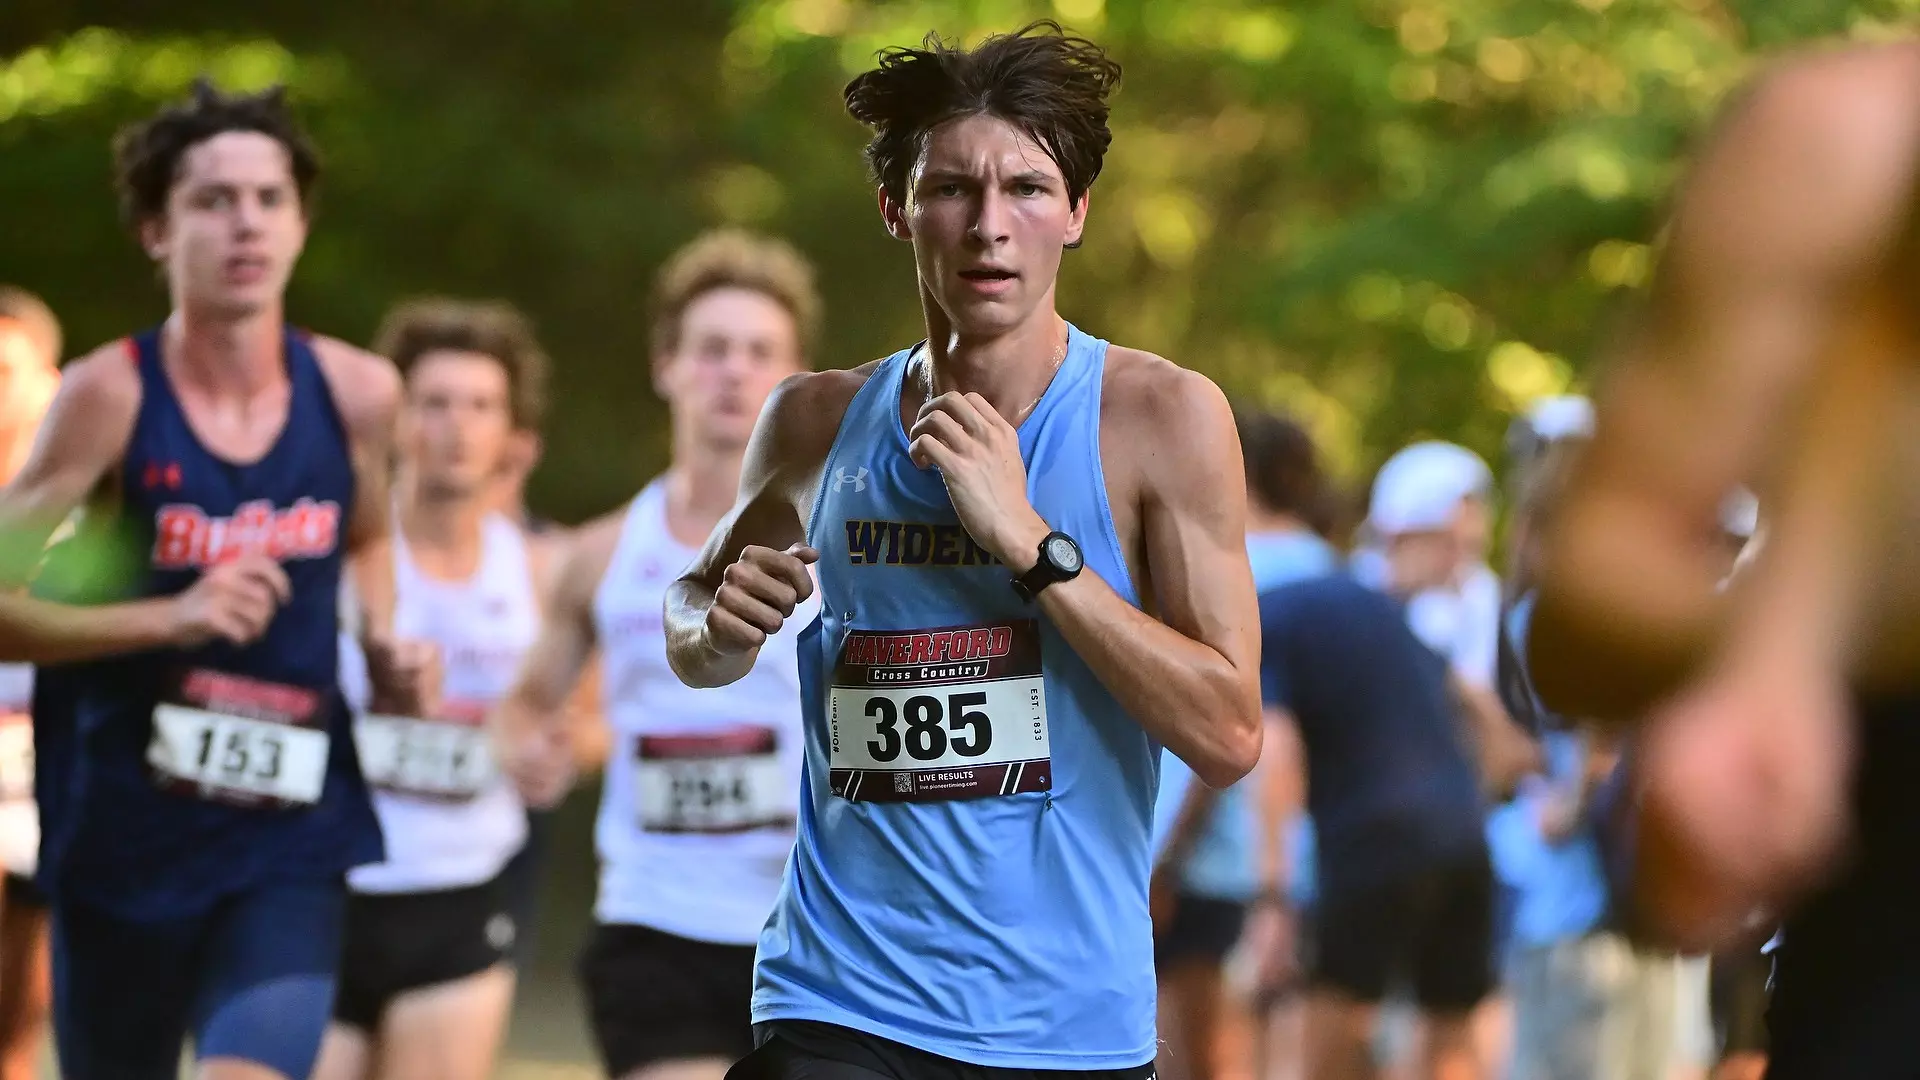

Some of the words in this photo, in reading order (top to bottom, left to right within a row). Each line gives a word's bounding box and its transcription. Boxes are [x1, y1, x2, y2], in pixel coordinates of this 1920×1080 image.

[845, 520, 1003, 566] WIDEN
[845, 626, 1012, 665] HAVERFORD
[874, 669, 911, 680] Cross
[920, 665, 981, 679] Country
[1030, 688, 1039, 710] EST.
[831, 696, 840, 753] #OneTeam
[864, 691, 993, 763] 385
[1033, 716, 1042, 741] 1833
[918, 773, 936, 782] LIVE
[938, 770, 974, 781] RESULTS
[919, 780, 978, 790] live.pioneertiming.com
